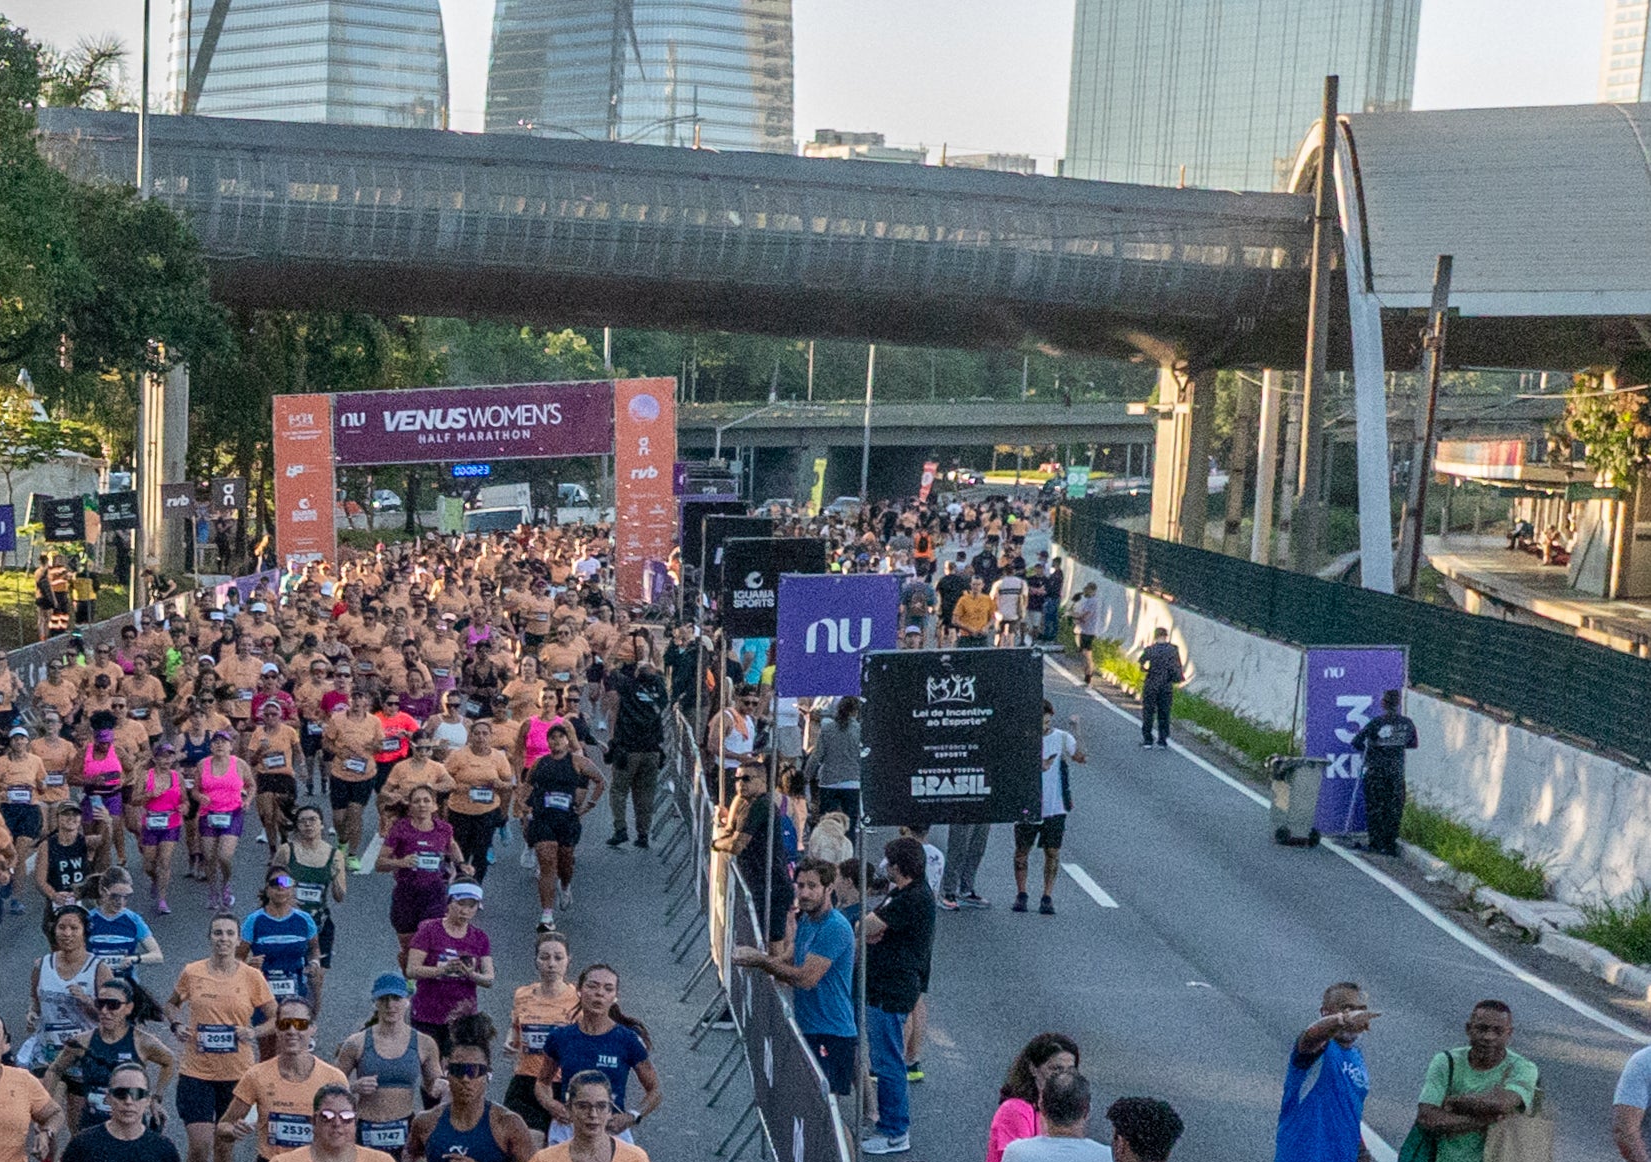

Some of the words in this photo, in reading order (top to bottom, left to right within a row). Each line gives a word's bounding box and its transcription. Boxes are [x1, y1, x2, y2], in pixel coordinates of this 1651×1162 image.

[418, 432, 451, 445] HALF
[457, 429, 531, 443] MARATHON
[733, 590, 775, 599] IGUANA
[733, 599, 775, 609] SPORTS
[806, 616, 872, 654] nu
[912, 709, 929, 719] Lei
[931, 709, 945, 718] de
[946, 708, 993, 718] Incentivo
[926, 720, 940, 728] ao
[1334, 695, 1373, 745] 3
[911, 775, 992, 798] BRASIL
[282, 1124, 311, 1136] 2539
[377, 1131, 400, 1140] 1747
